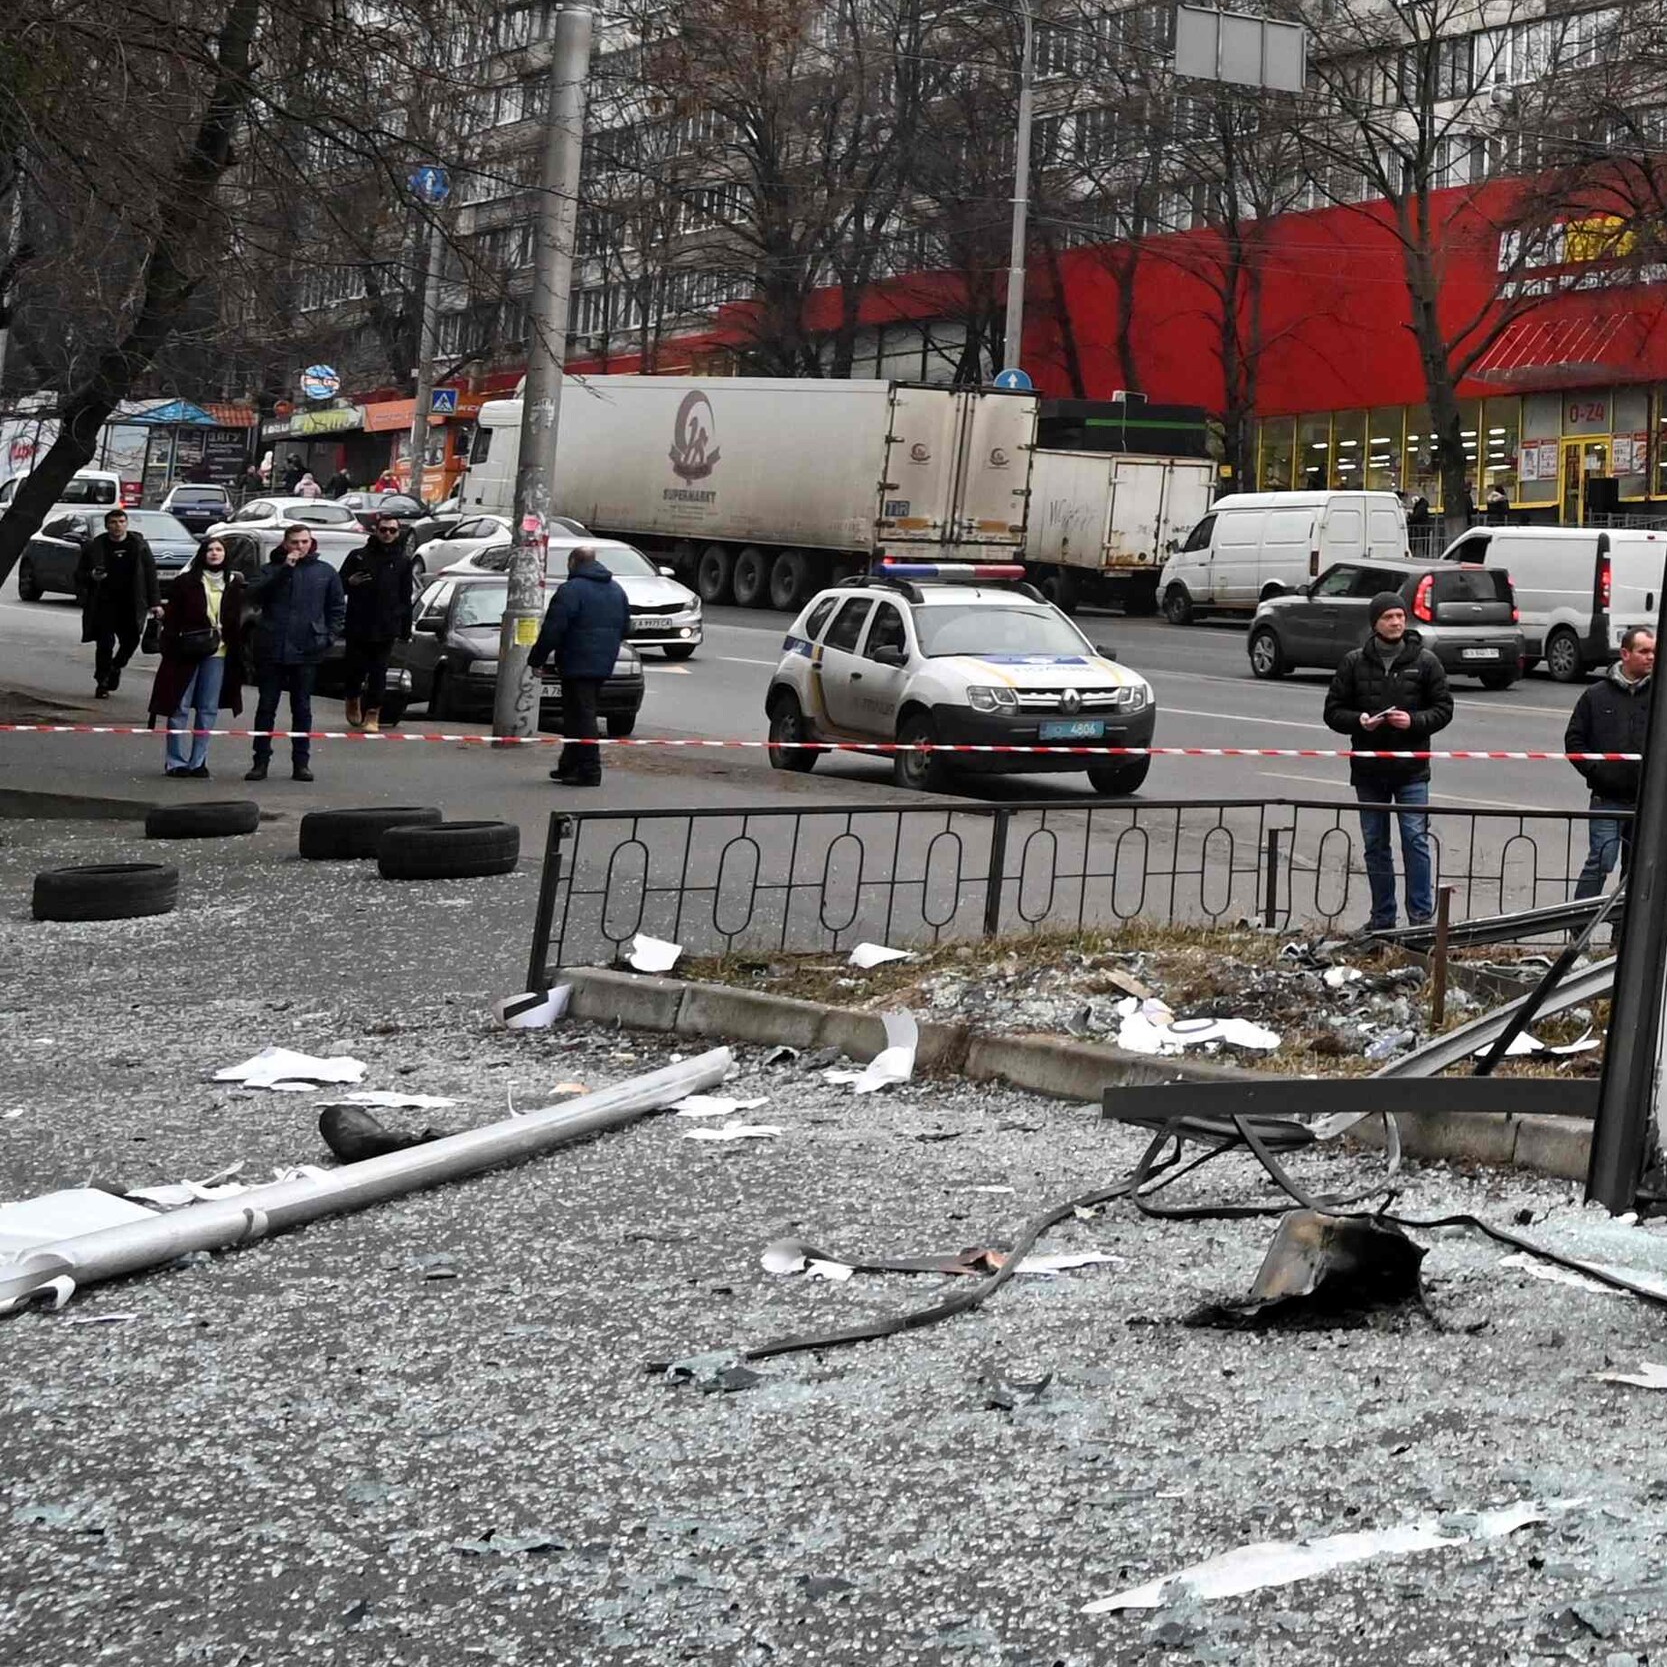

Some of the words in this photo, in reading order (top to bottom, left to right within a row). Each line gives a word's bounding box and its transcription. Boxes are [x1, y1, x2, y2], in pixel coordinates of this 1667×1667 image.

[1569, 403, 1605, 423] 0-24
[886, 501, 910, 517] TIR
[1070, 722, 1097, 736] 4806
